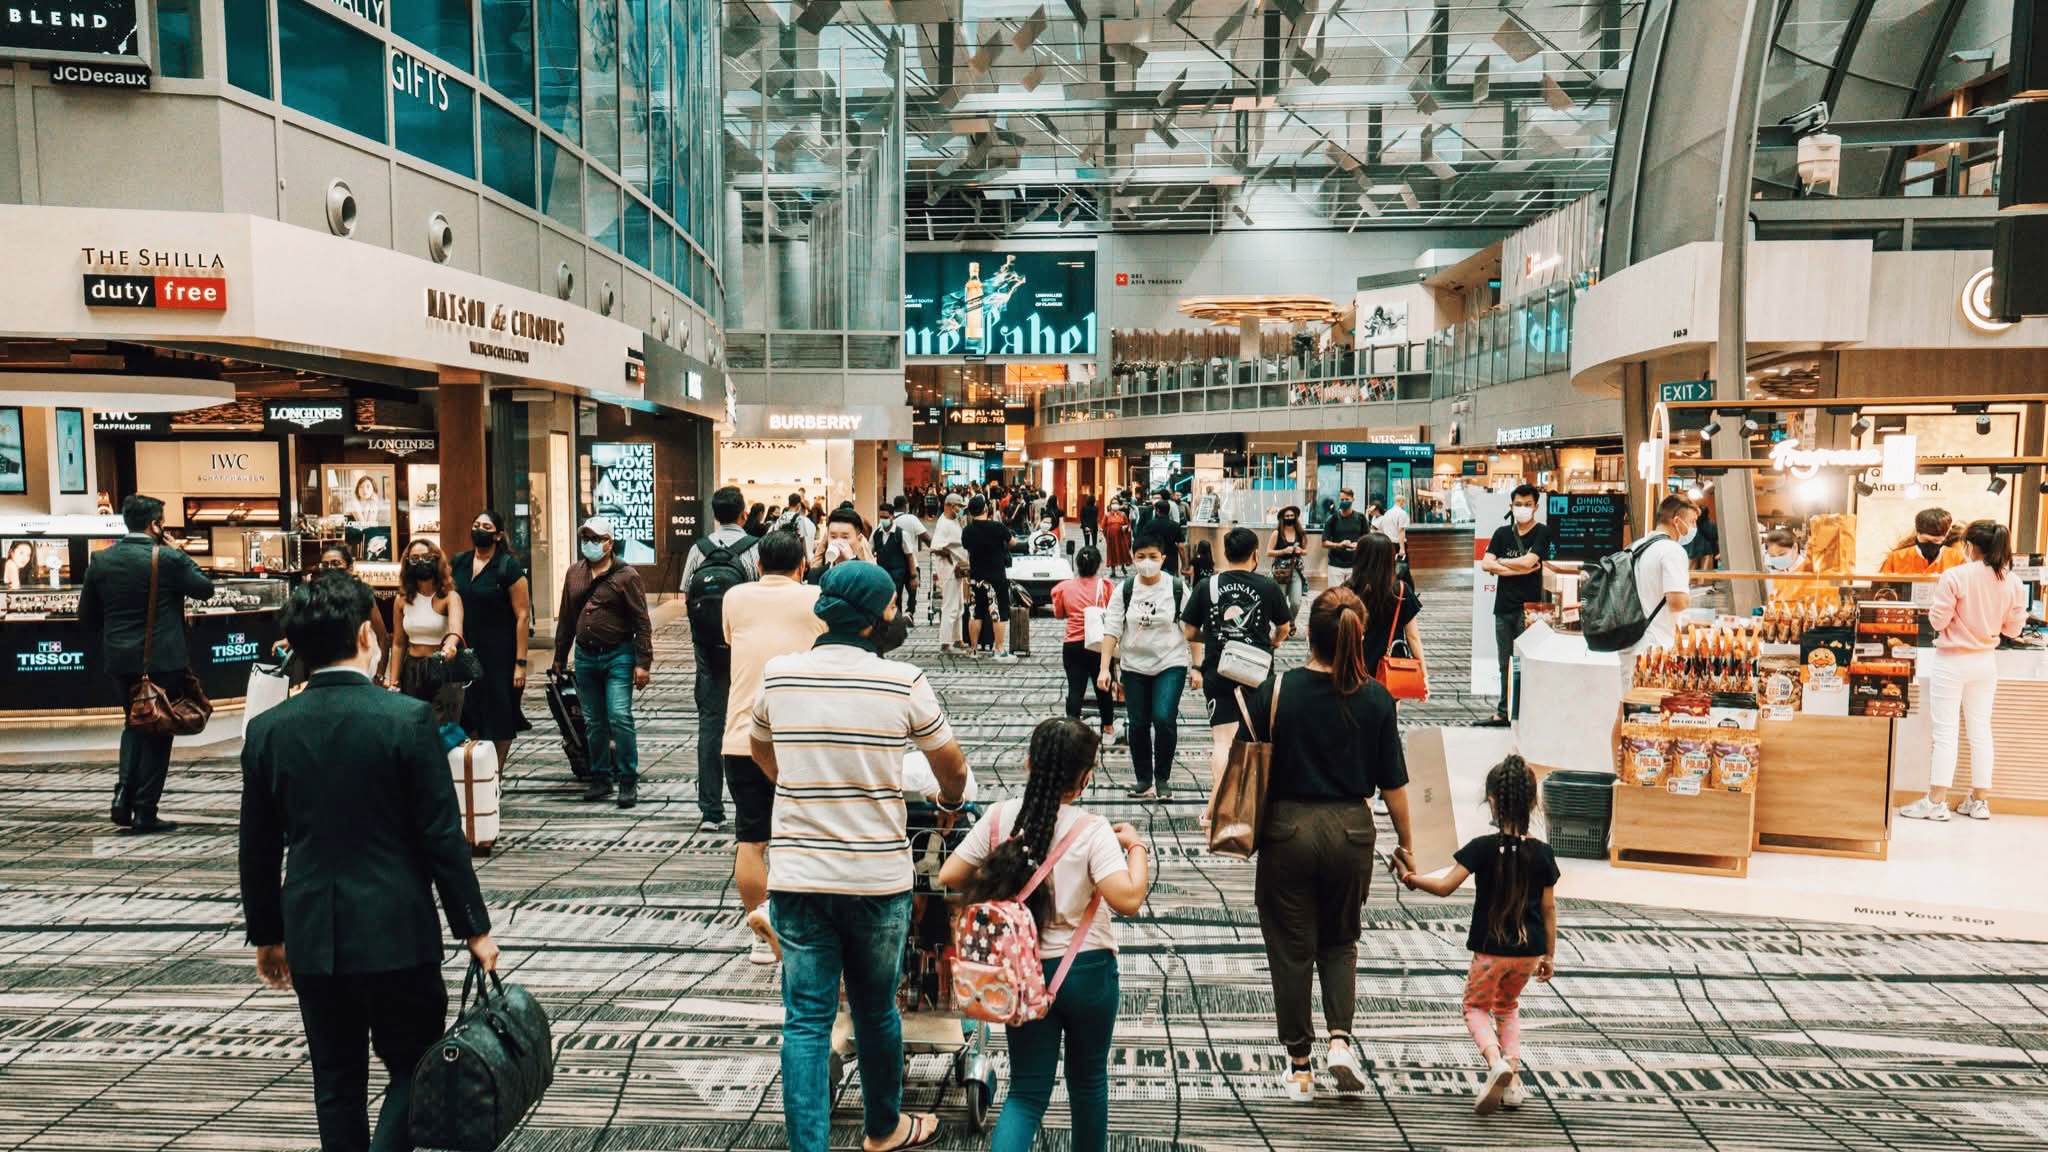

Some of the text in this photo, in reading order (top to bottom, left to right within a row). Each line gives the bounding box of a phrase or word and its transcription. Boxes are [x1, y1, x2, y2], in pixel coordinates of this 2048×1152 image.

[9, 8, 108, 28] BLEND
[53, 66, 147, 85] JCDecaux
[391, 48, 449, 112] GIFTS
[81, 247, 225, 269] THE SHILLA
[91, 279, 217, 305] duty free
[1663, 384, 1695, 401] EXIT
[270, 407, 343, 420] LONGINES
[769, 415, 862, 430] BURBERRY
[368, 439, 435, 449] LONGINES
[1330, 444, 1348, 455] UOB
[622, 445, 653, 457] LIVE
[211, 453, 250, 470] IWC
[615, 457, 653, 469] LOVE
[608, 469, 653, 481] WORK
[618, 481, 653, 492] PLAY
[602, 493, 653, 504] DREAM
[1576, 497, 1610, 505] DINING
[623, 505, 653, 516] WIN
[608, 517, 654, 528] REATE
[672, 516, 696, 524] BOSS
[611, 529, 654, 540] SPIRE
[1217, 583, 1261, 602] RIGINALS
[211, 643, 259, 657] TISSOT
[17, 653, 84, 666] TISSOT
[1854, 907, 1996, 926] Mind Your Step
